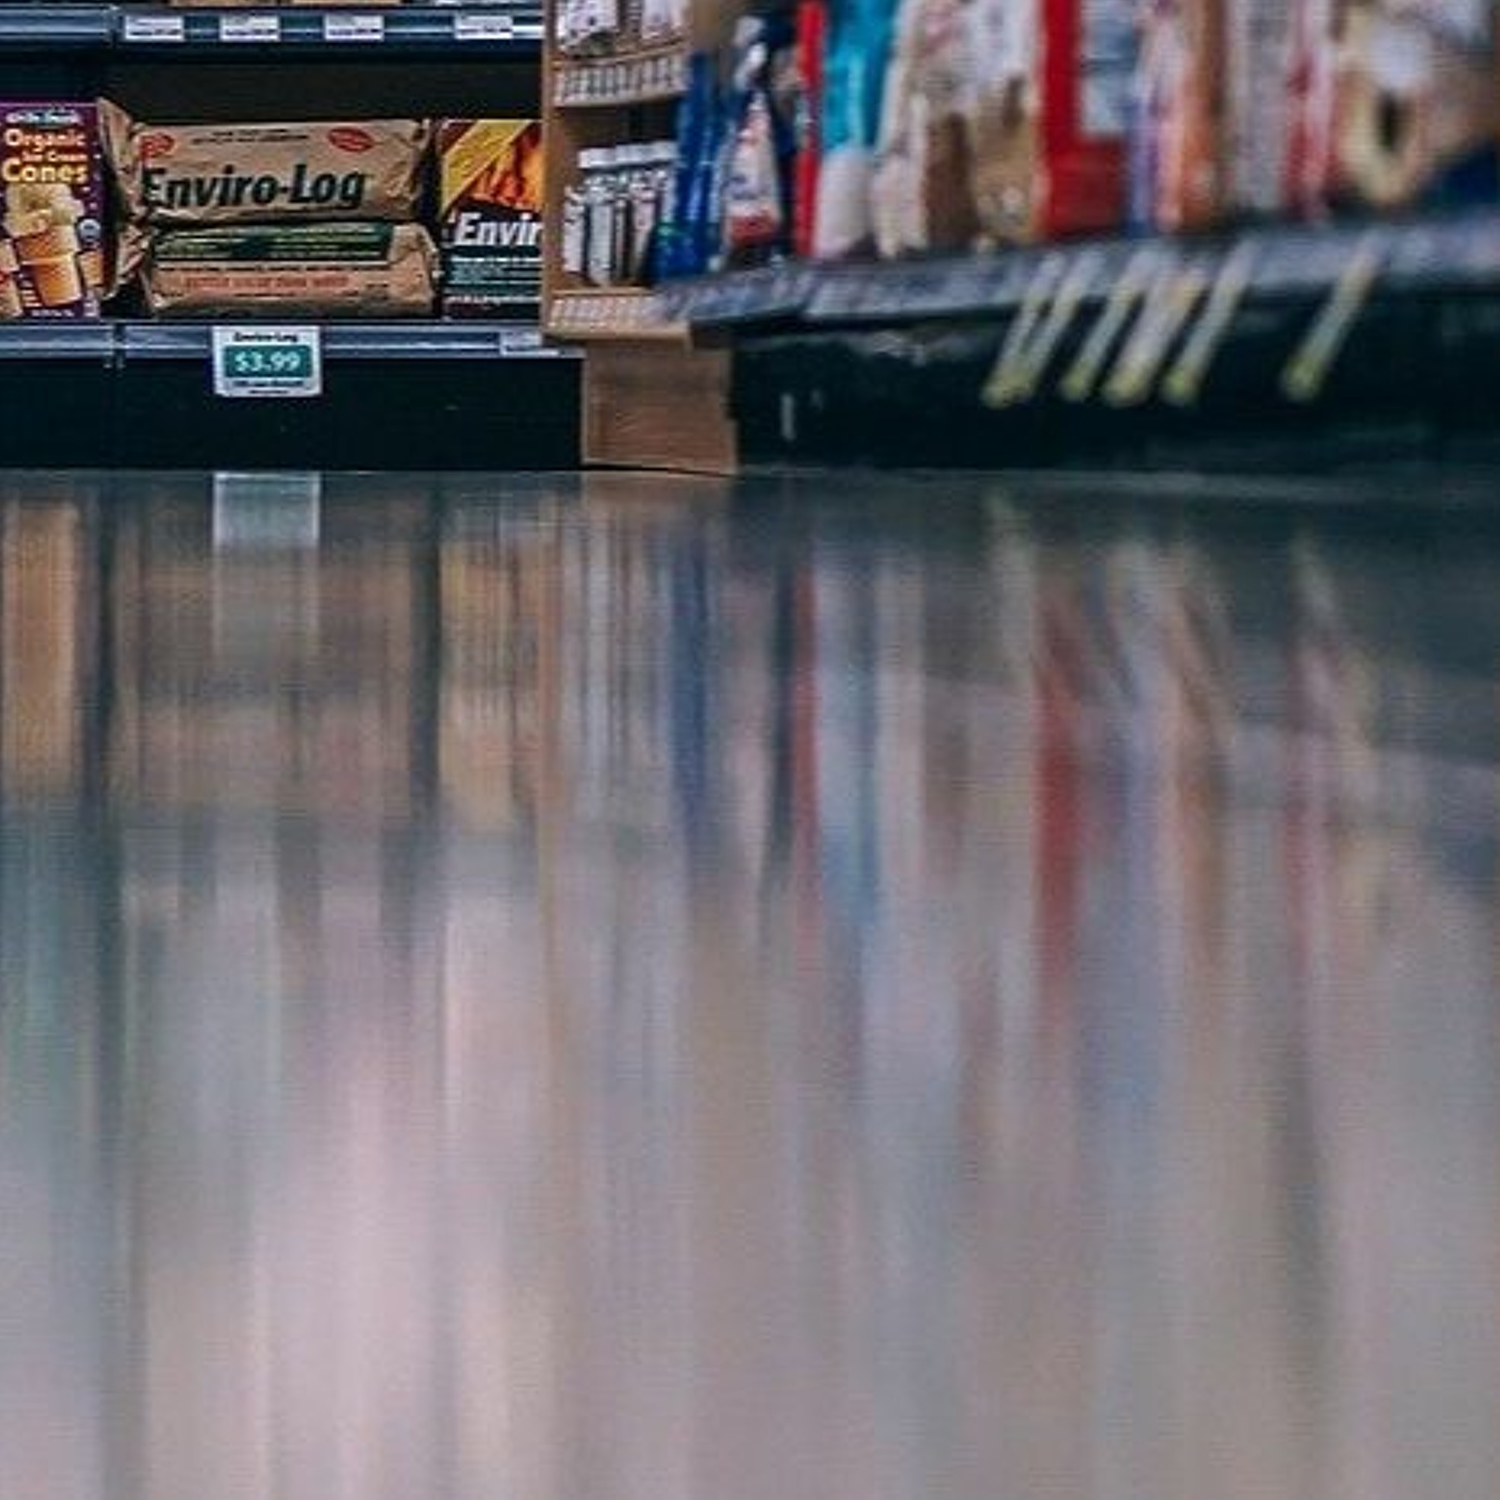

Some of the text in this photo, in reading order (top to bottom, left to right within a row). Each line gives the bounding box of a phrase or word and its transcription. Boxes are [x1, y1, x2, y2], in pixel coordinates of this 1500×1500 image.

[3, 128, 86, 151] Organic
[1, 158, 88, 182] Cones
[142, 163, 369, 208] Enviro-Log
[235, 351, 301, 373] $3.99
